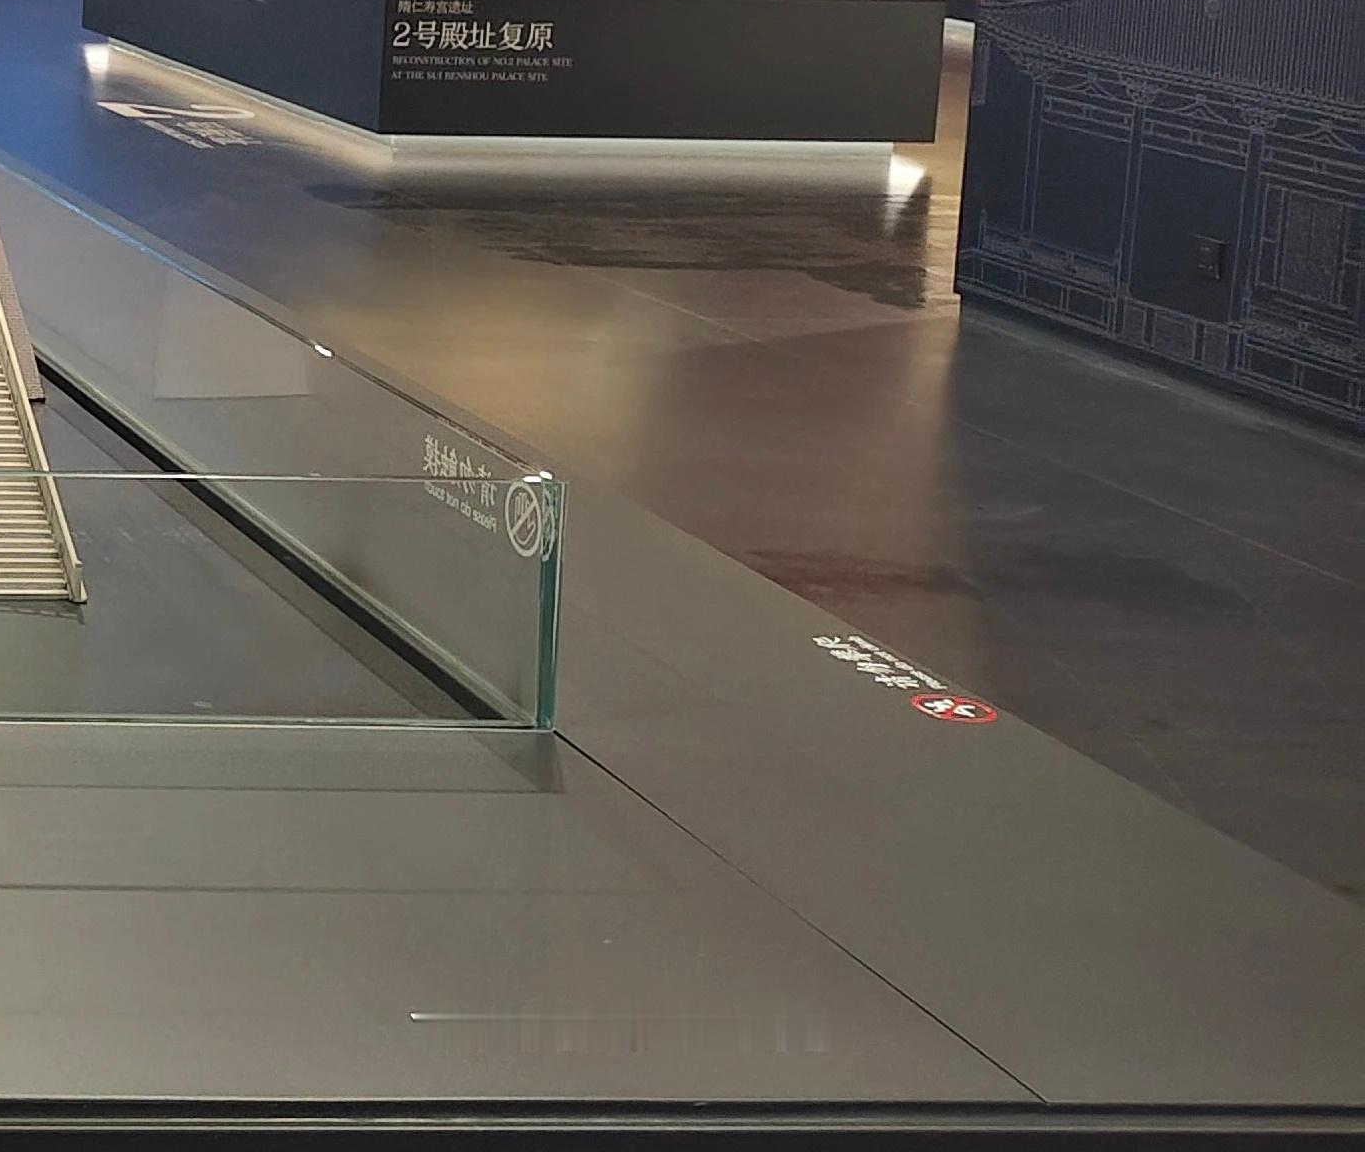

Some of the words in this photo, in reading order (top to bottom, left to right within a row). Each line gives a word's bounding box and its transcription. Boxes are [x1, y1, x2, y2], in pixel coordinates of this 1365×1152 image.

[397, 0, 474, 15] 隋仁寿宫遗址
[393, 20, 554, 52] 2号殿址复原
